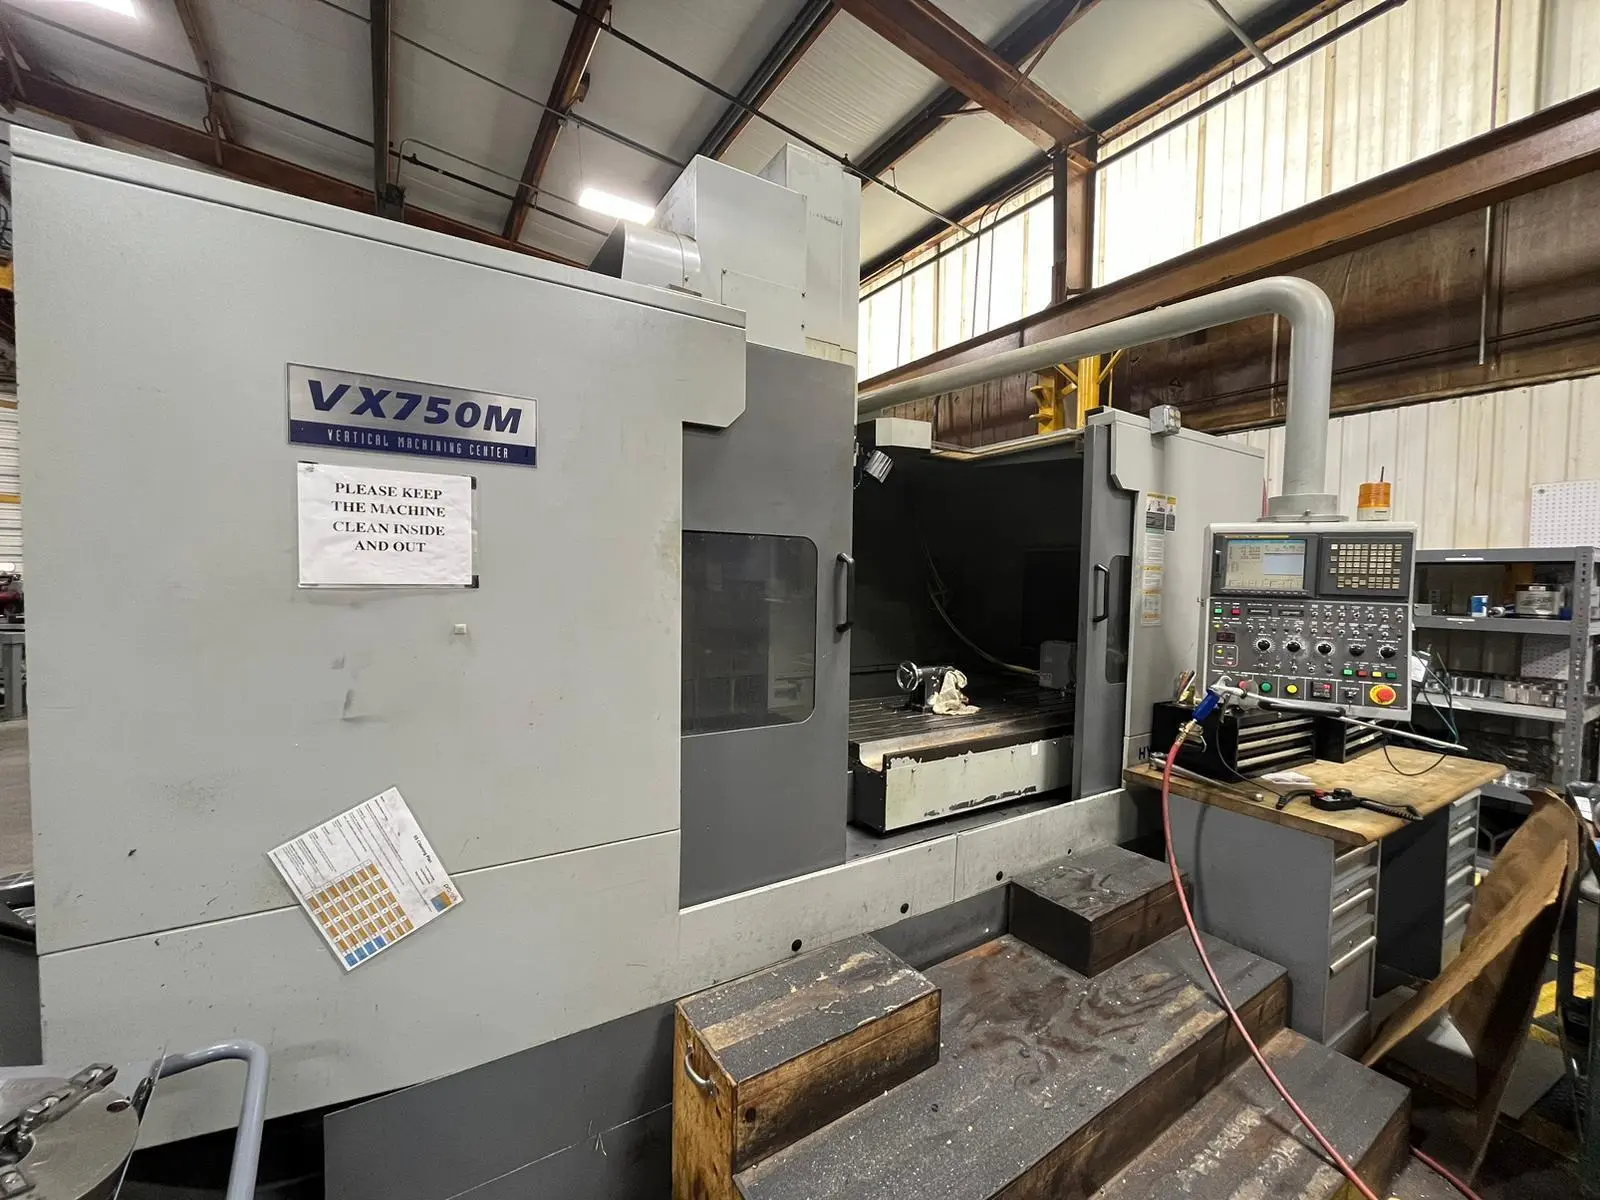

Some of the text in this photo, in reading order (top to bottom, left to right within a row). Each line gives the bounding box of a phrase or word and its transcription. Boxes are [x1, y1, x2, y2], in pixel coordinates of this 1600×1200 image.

[308, 379, 522, 434] VX750M
[327, 429, 508, 459] VERTICAL MACHINING CENTER
[335, 482, 443, 500] PLEASE KEEP
[331, 500, 446, 518] THE MACHINE
[332, 520, 445, 536] CLEAN INSIDE
[355, 540, 426, 552] AND OUT
